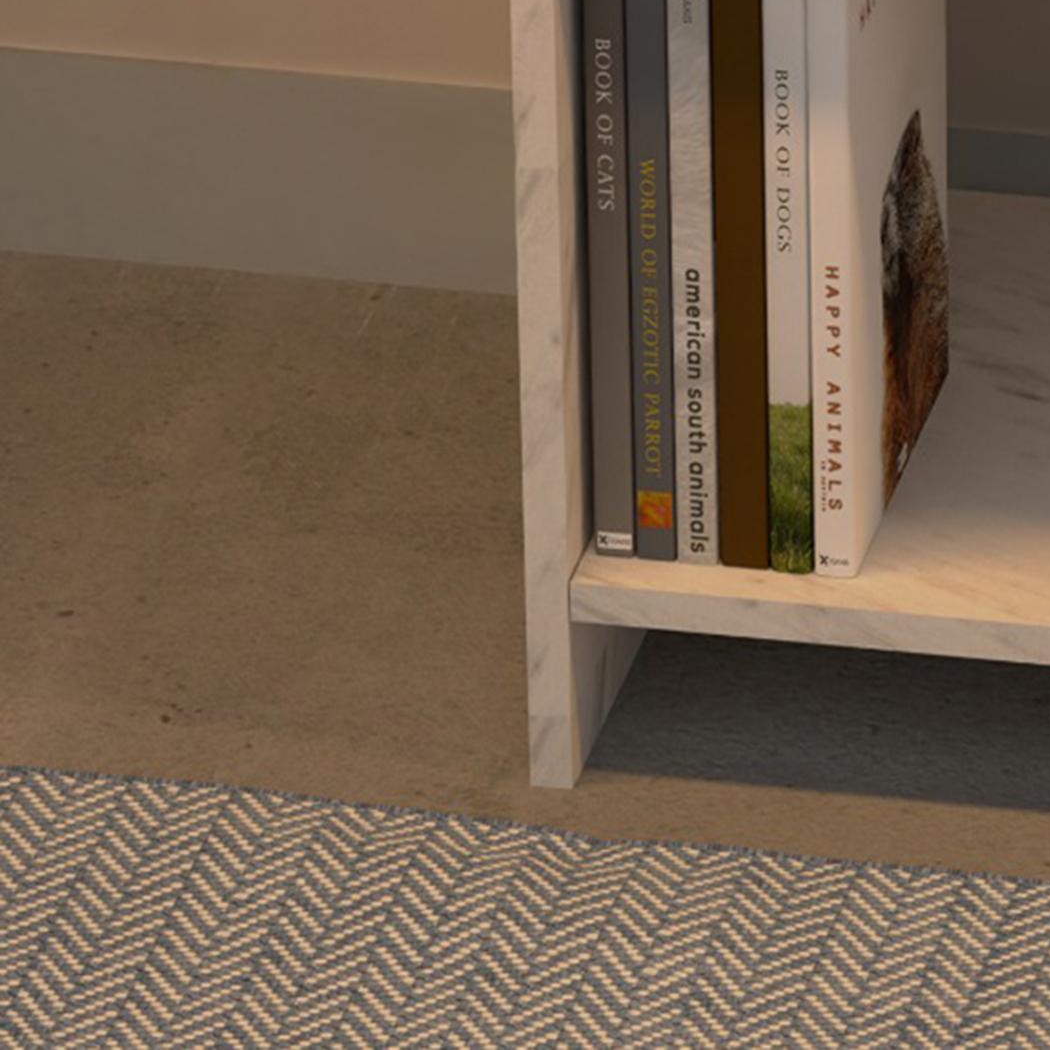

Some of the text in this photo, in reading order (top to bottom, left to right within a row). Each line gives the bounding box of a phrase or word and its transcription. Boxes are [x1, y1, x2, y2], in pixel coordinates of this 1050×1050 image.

[595, 38, 615, 211] BOOK OF CATS
[775, 69, 793, 252] BOOK OF DOGS
[640, 158, 661, 477] WORLD OF EGZOTIC PARROT
[685, 268, 709, 554] american south animals
[825, 266, 843, 511] HAPPY ANIMALS
